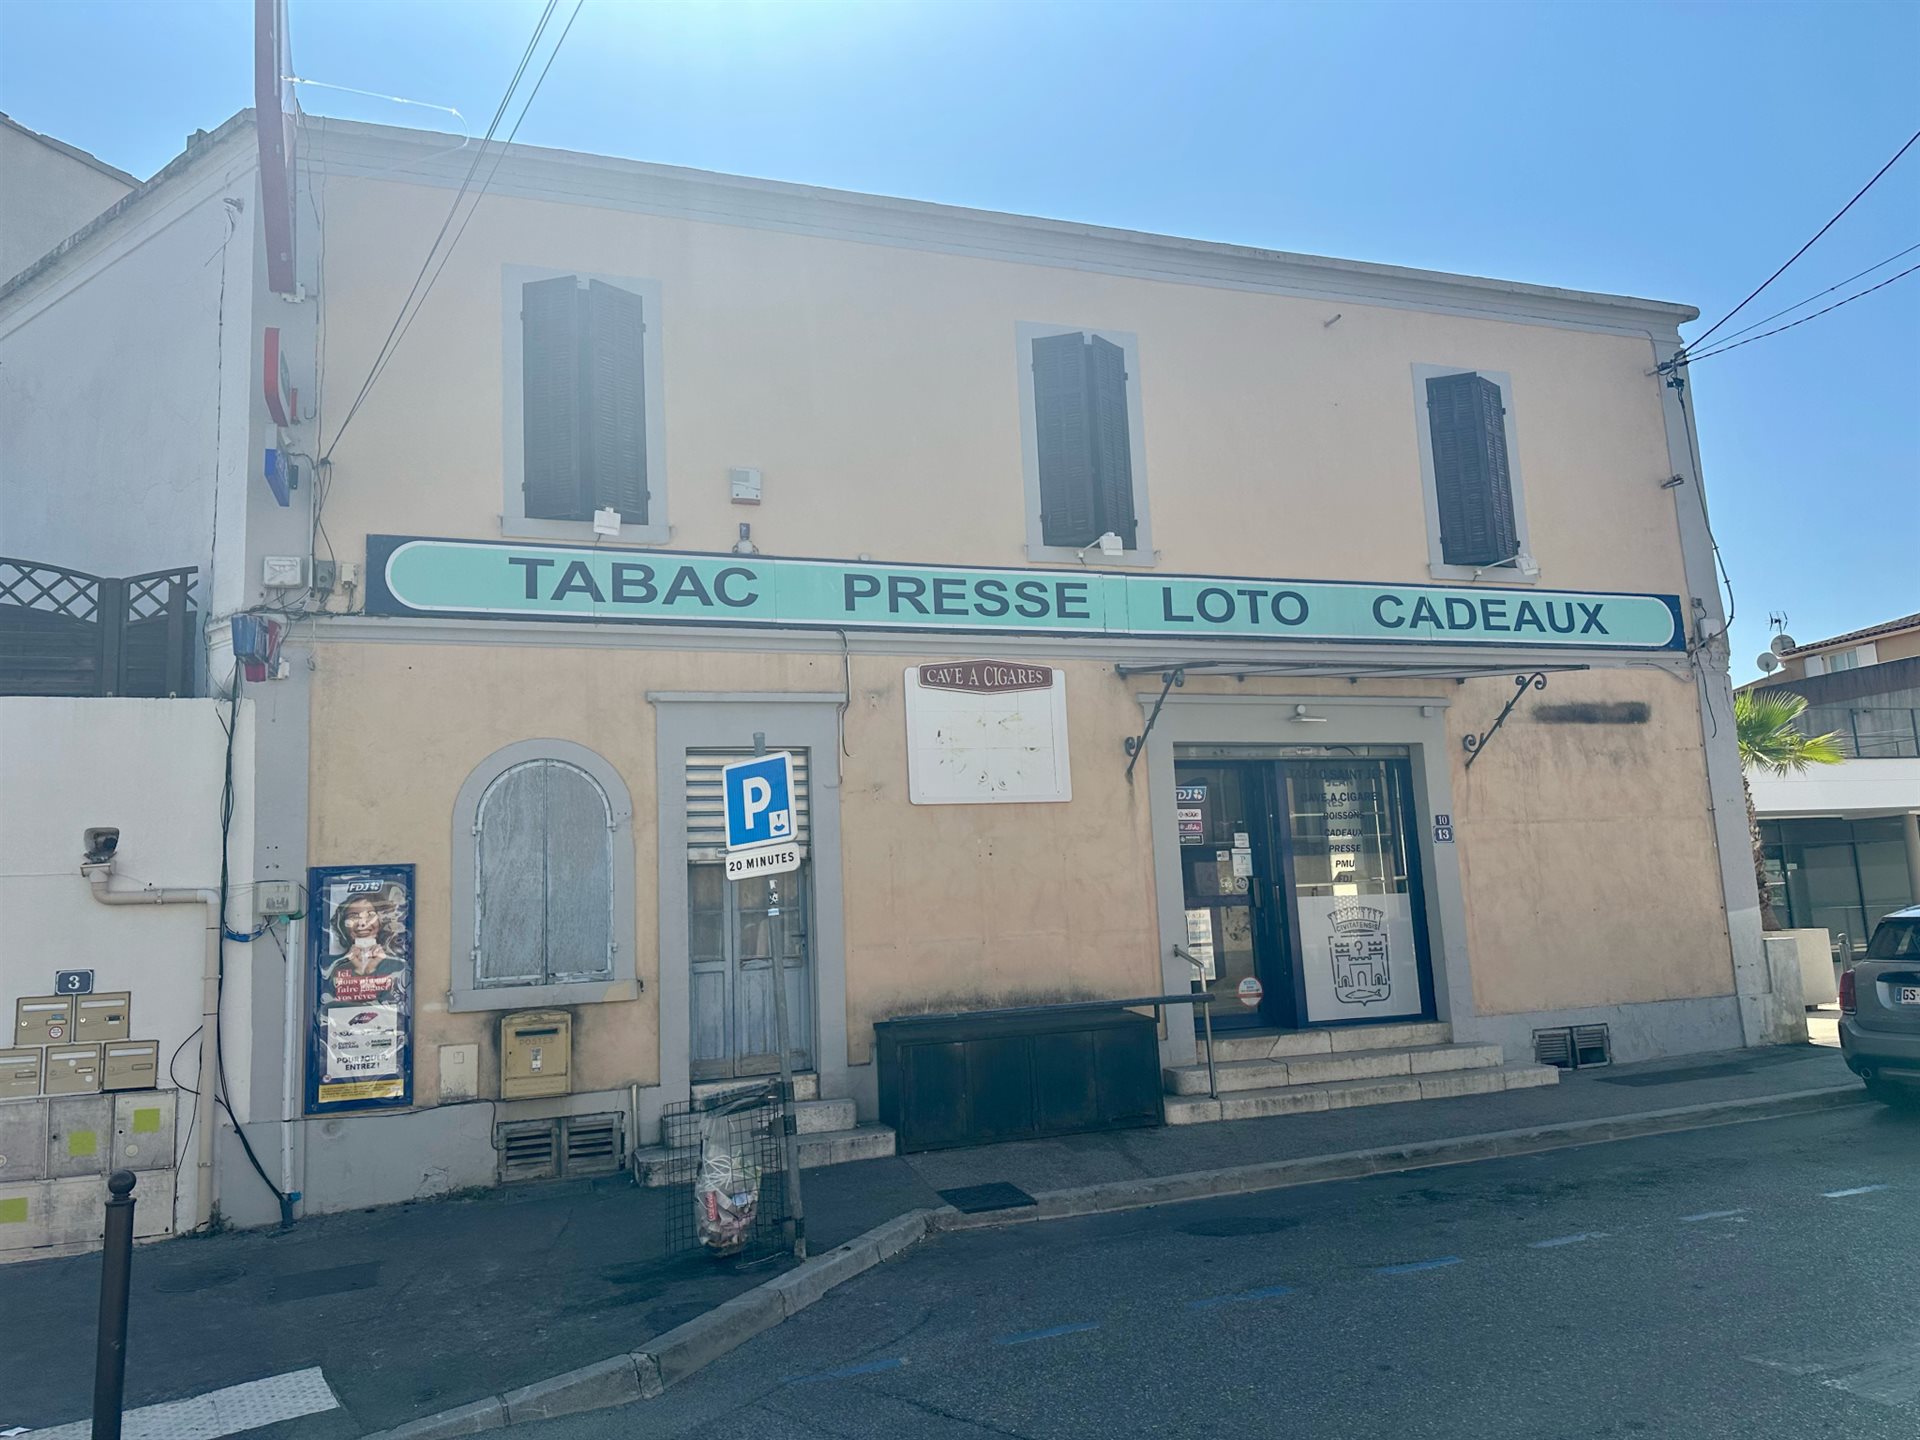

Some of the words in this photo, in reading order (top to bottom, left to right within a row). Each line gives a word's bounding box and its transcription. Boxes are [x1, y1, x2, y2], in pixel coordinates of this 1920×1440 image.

[508, 556, 759, 608] TABAC
[843, 573, 1091, 619] PRESSE
[1162, 586, 1309, 626] LOTO
[1372, 594, 1610, 635] CADEAUX
[926, 668, 964, 685] CAVE
[968, 667, 980, 686] A
[983, 665, 1043, 687] CIGARES
[1330, 792, 1338, 801] A
[742, 776, 772, 830] P
[1323, 811, 1364, 820] BOISSONS
[1438, 815, 1447, 825] 10
[1325, 828, 1363, 837] CADEAUX
[1438, 829, 1450, 840] 13
[1328, 844, 1361, 853] PRESSE
[729, 860, 742, 872] 20
[746, 851, 795, 870] MINUTES
[1335, 859, 1355, 868] PMU
[1338, 874, 1353, 883] FDJ
[349, 883, 369, 891] FDJ
[68, 975, 81, 990] 3
[336, 1056, 359, 1064] POUR
[345, 1062, 376, 1071] ENTREZ
